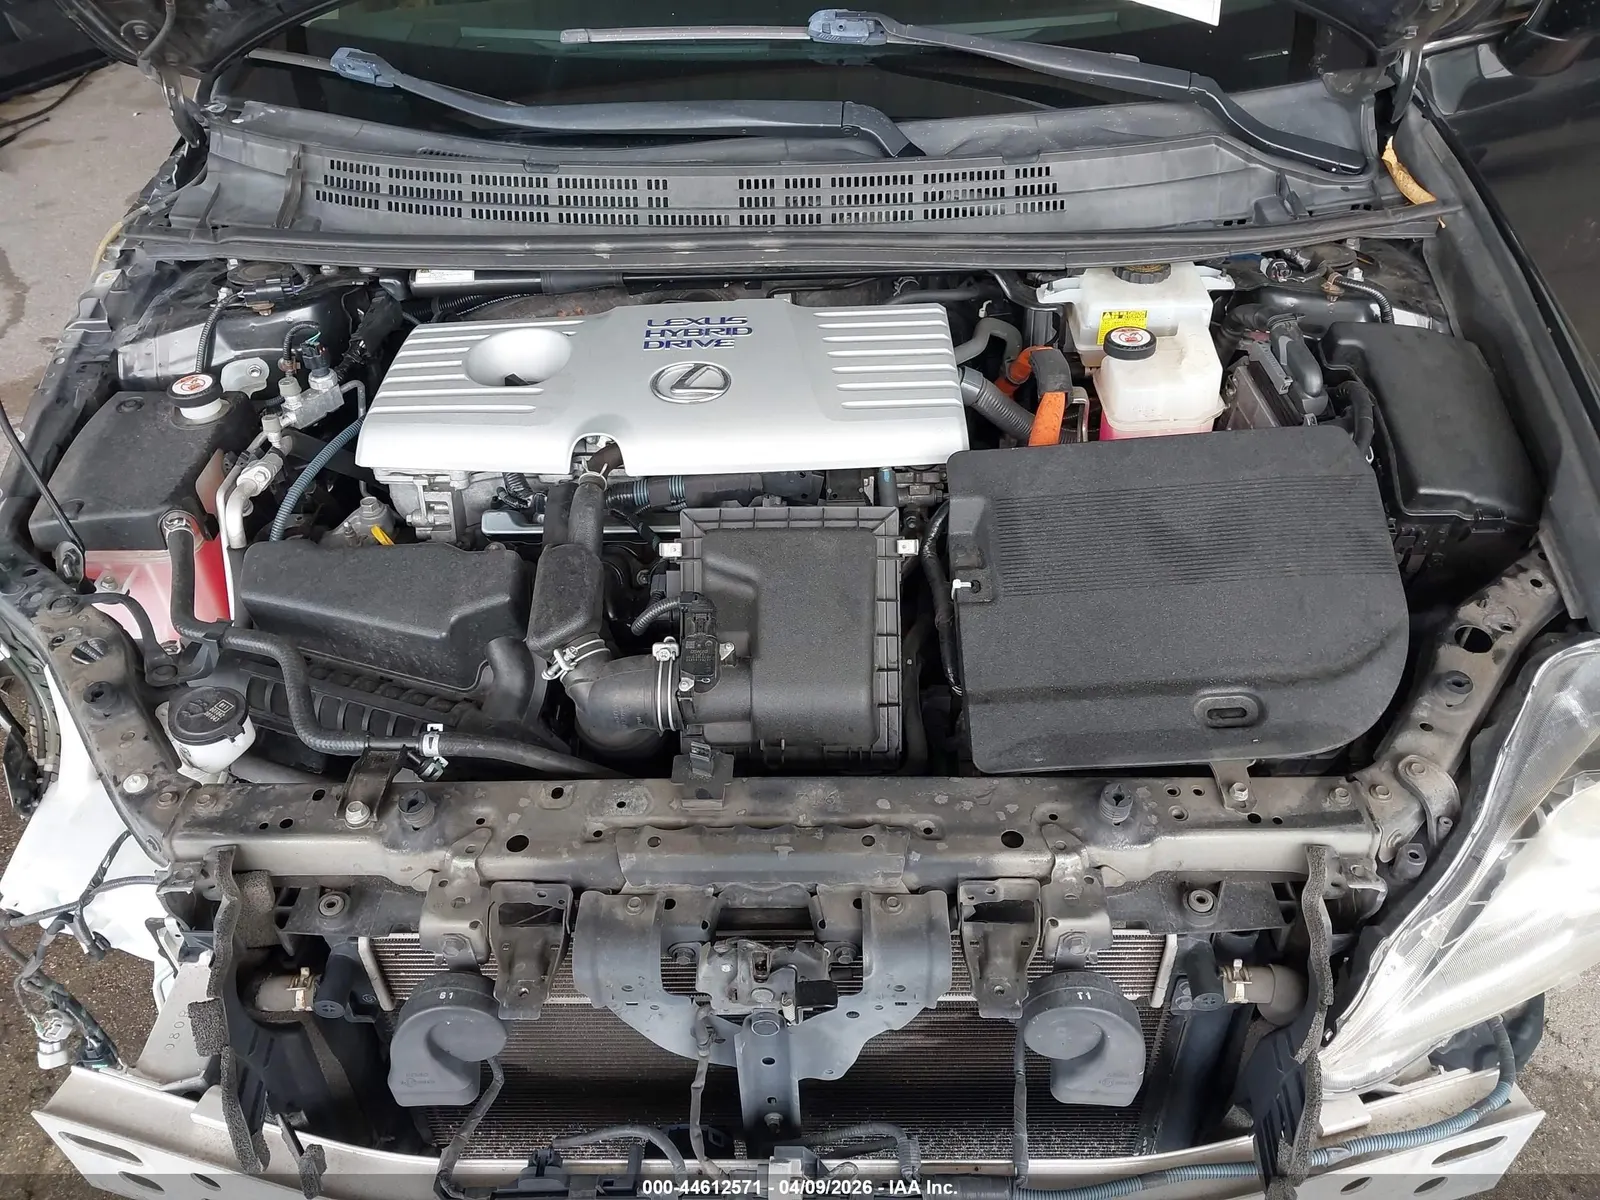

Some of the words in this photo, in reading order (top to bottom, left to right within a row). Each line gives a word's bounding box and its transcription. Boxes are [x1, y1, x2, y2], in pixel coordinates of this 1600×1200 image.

[647, 316, 748, 327] LEXUS
[645, 327, 753, 339] HYBRID
[643, 339, 736, 350] DRIVE
[1076, 991, 1092, 1000] T1
